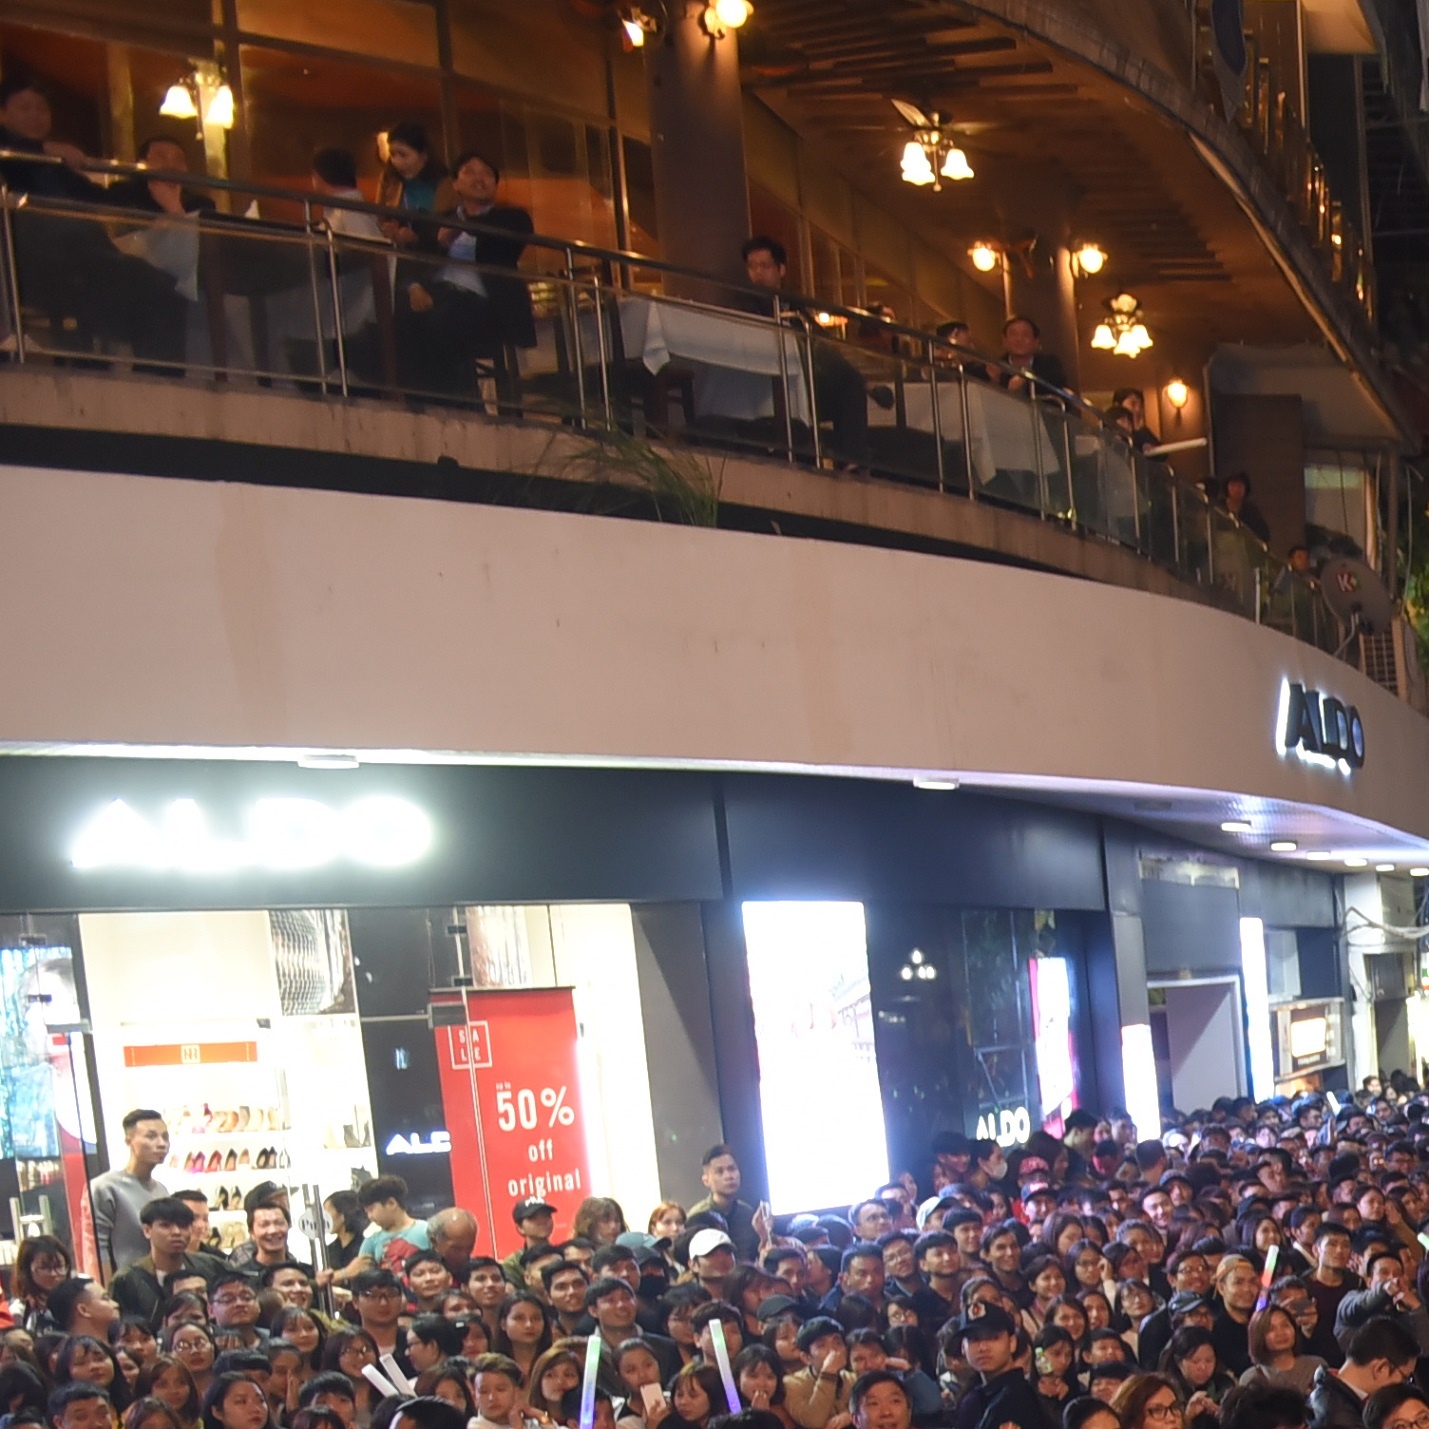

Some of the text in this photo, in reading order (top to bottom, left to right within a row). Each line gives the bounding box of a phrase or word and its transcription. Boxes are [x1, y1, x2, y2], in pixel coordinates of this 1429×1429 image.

[1276, 680, 1366, 774] ALDO
[72, 797, 432, 869] ALDO
[496, 1086, 575, 1132] 50%
[976, 1106, 1031, 1147] ALDO
[528, 1139, 553, 1162] off
[507, 1168, 581, 1198] original
